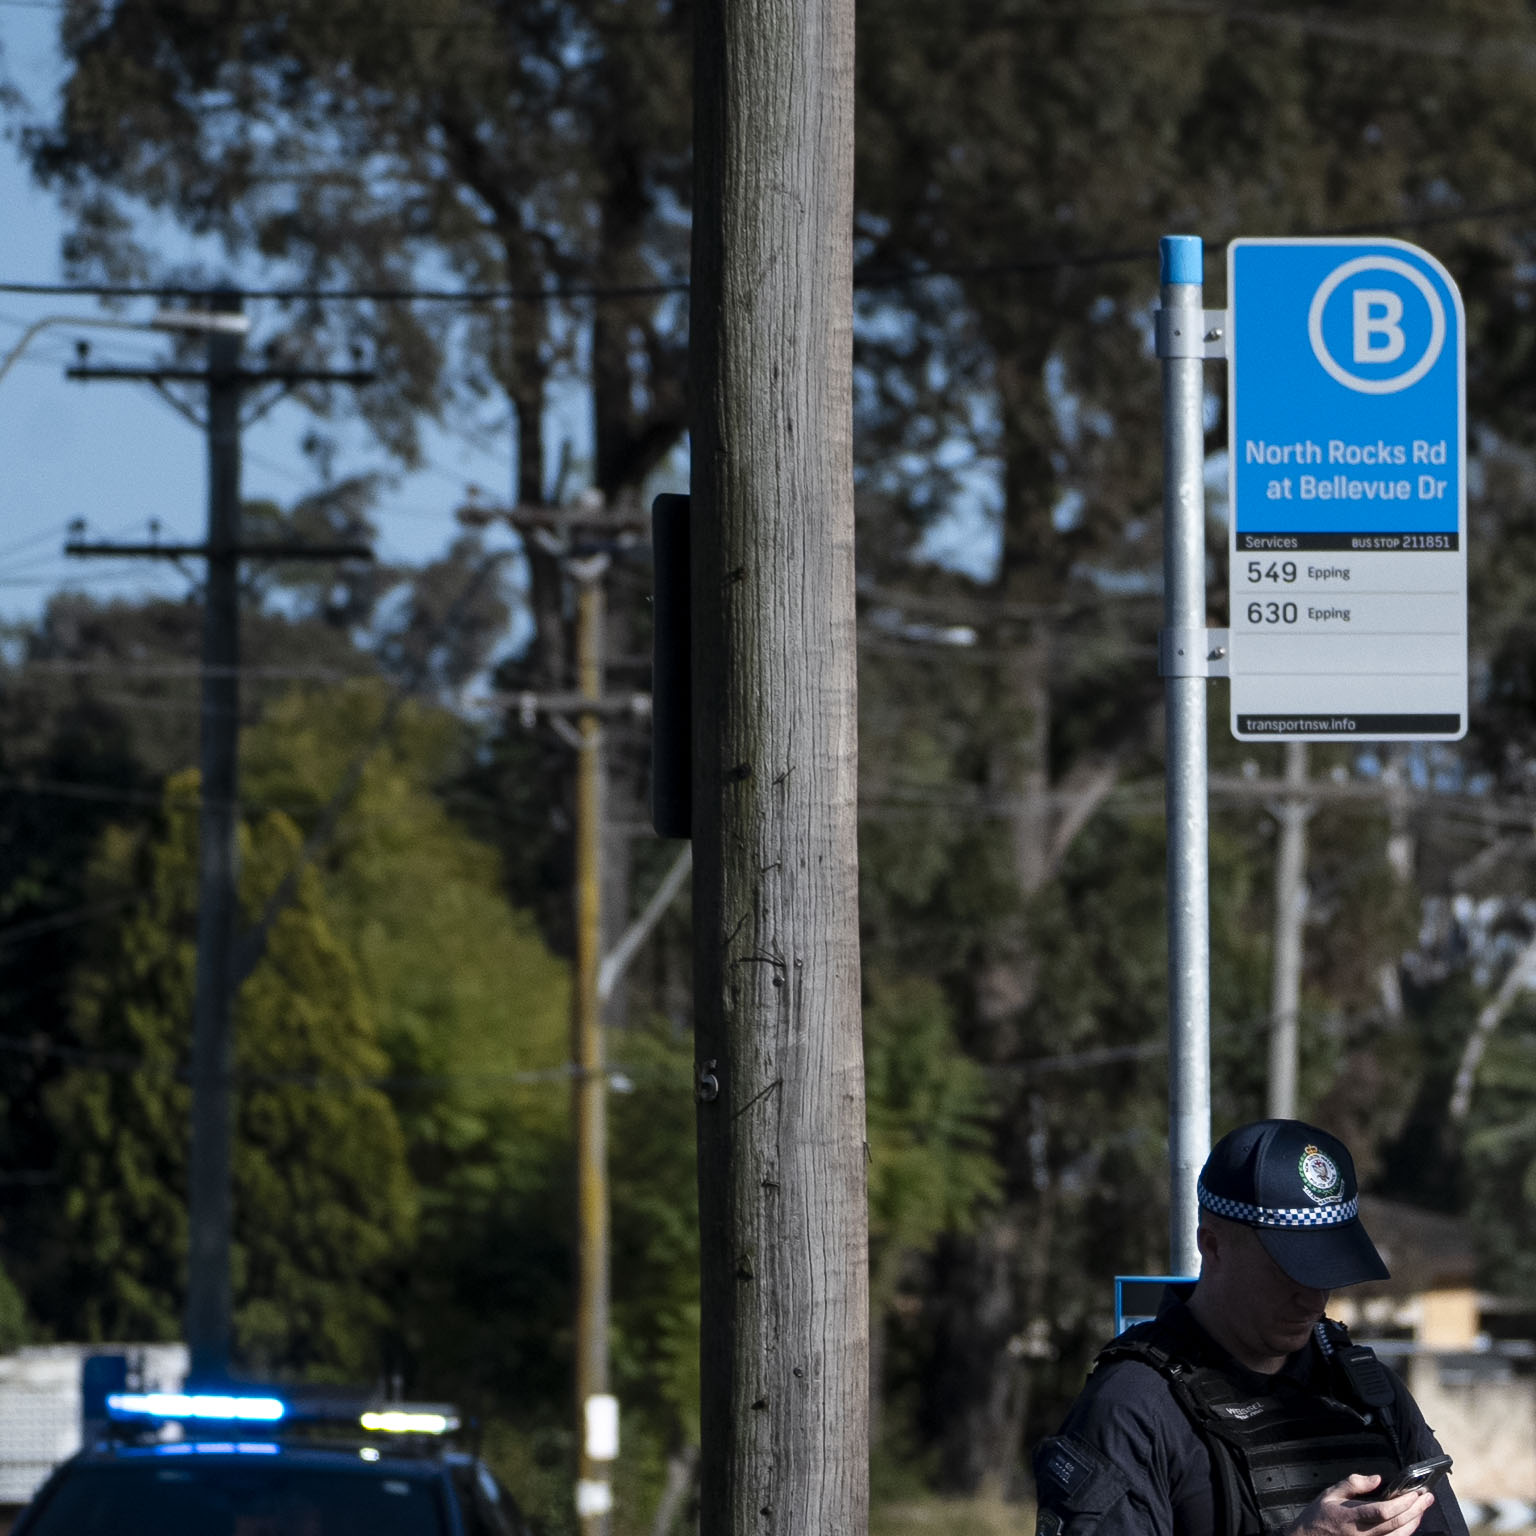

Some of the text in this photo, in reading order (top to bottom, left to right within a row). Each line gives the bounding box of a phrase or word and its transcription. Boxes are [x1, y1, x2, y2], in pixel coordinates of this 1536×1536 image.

[1352, 289, 1406, 365] B
[1245, 439, 1447, 465] North Rocks Rd
[1266, 475, 1447, 501] at Bellevue Dr
[1245, 535, 1298, 549] Services
[1351, 535, 1450, 549] BUS STOP 211851
[1247, 561, 1351, 583] 549 Epping
[1247, 602, 1351, 625] 630 Epping
[1246, 718, 1356, 733] transportnsw.info
